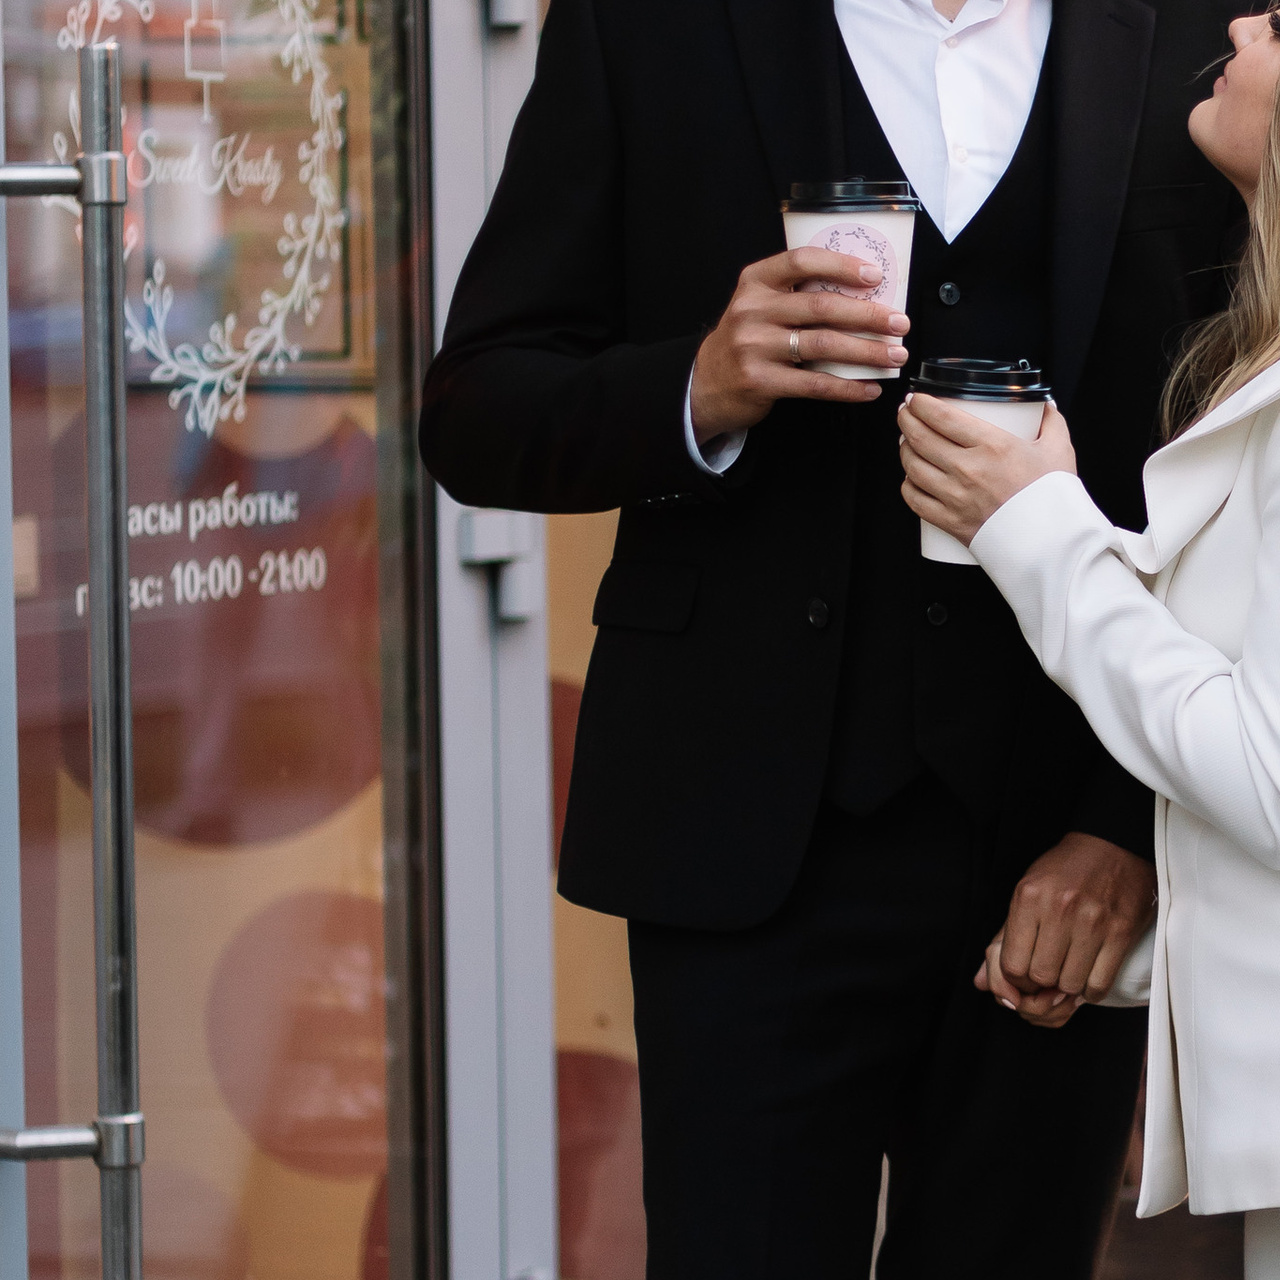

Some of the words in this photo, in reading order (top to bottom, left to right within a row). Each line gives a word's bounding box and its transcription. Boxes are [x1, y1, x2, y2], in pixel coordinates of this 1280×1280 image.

[128, 503, 182, 537] асы
[189, 482, 298, 542] работы:
[171, 556, 242, 605] 10:00
